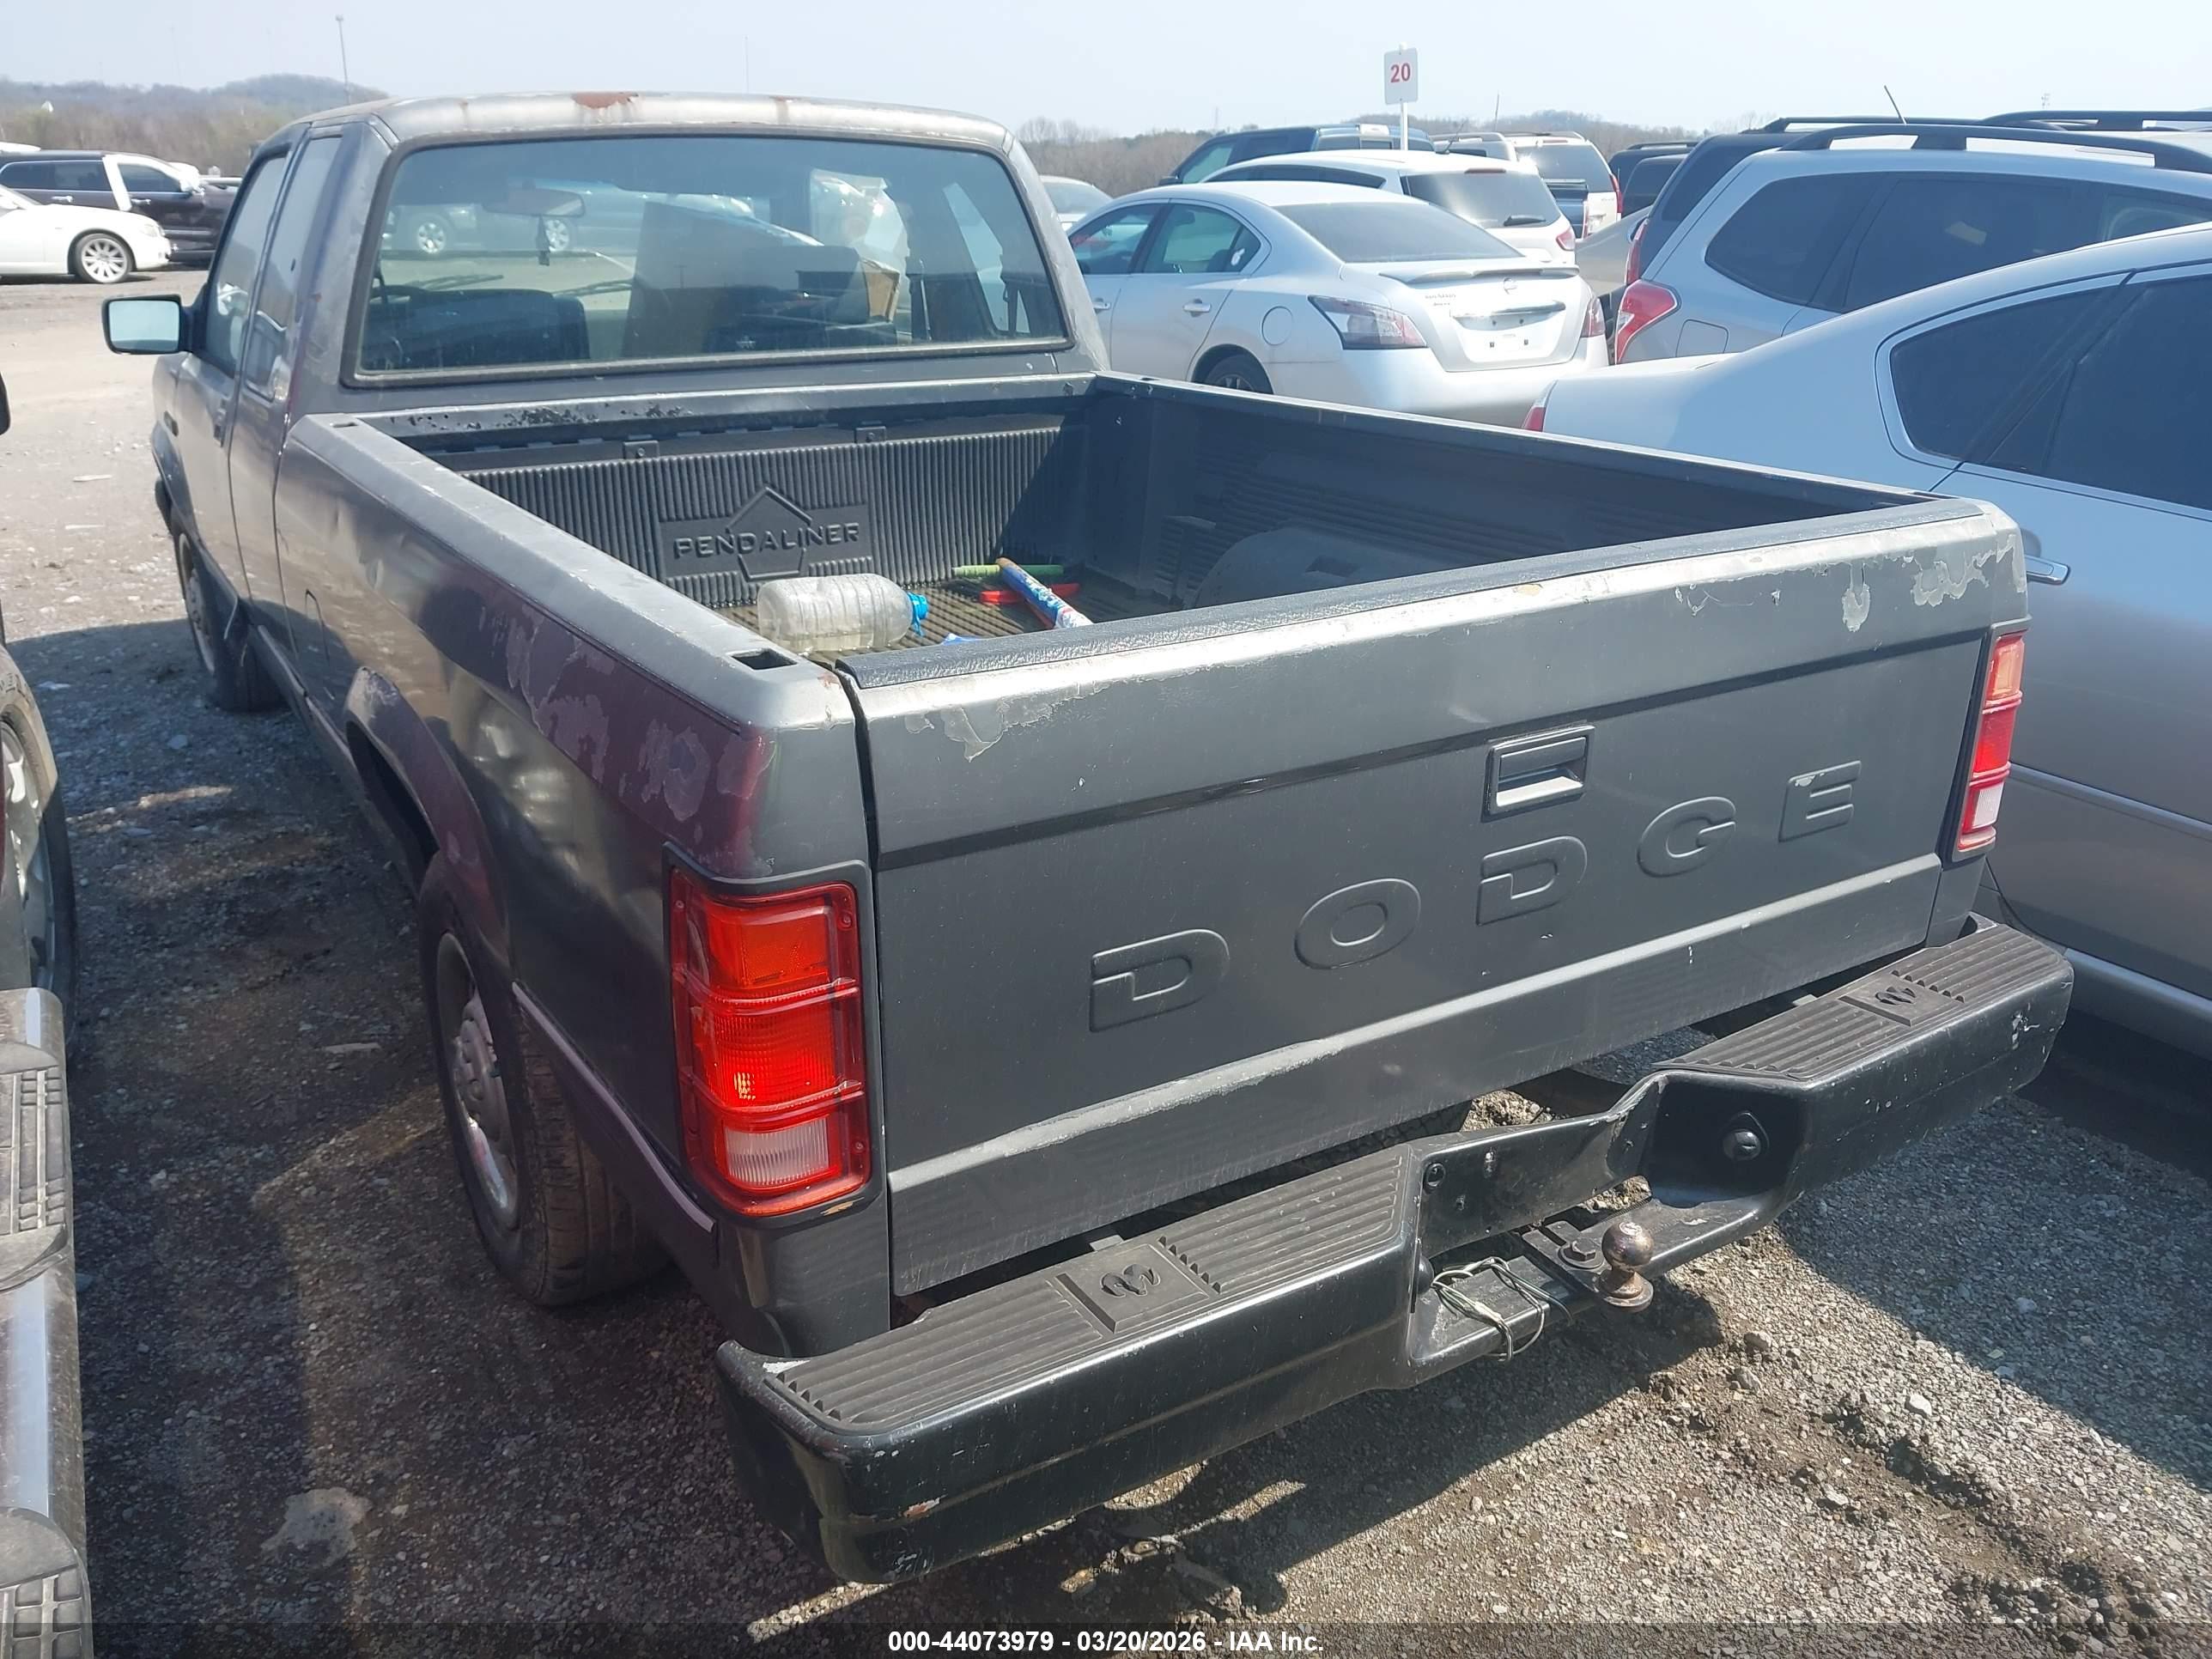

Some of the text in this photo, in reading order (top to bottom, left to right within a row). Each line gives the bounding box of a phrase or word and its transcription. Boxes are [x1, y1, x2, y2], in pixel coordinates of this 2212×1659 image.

[1390, 62, 1411, 83] 20
[674, 522, 860, 558] PENDALINER
[1089, 760, 1862, 1031] DODGE
